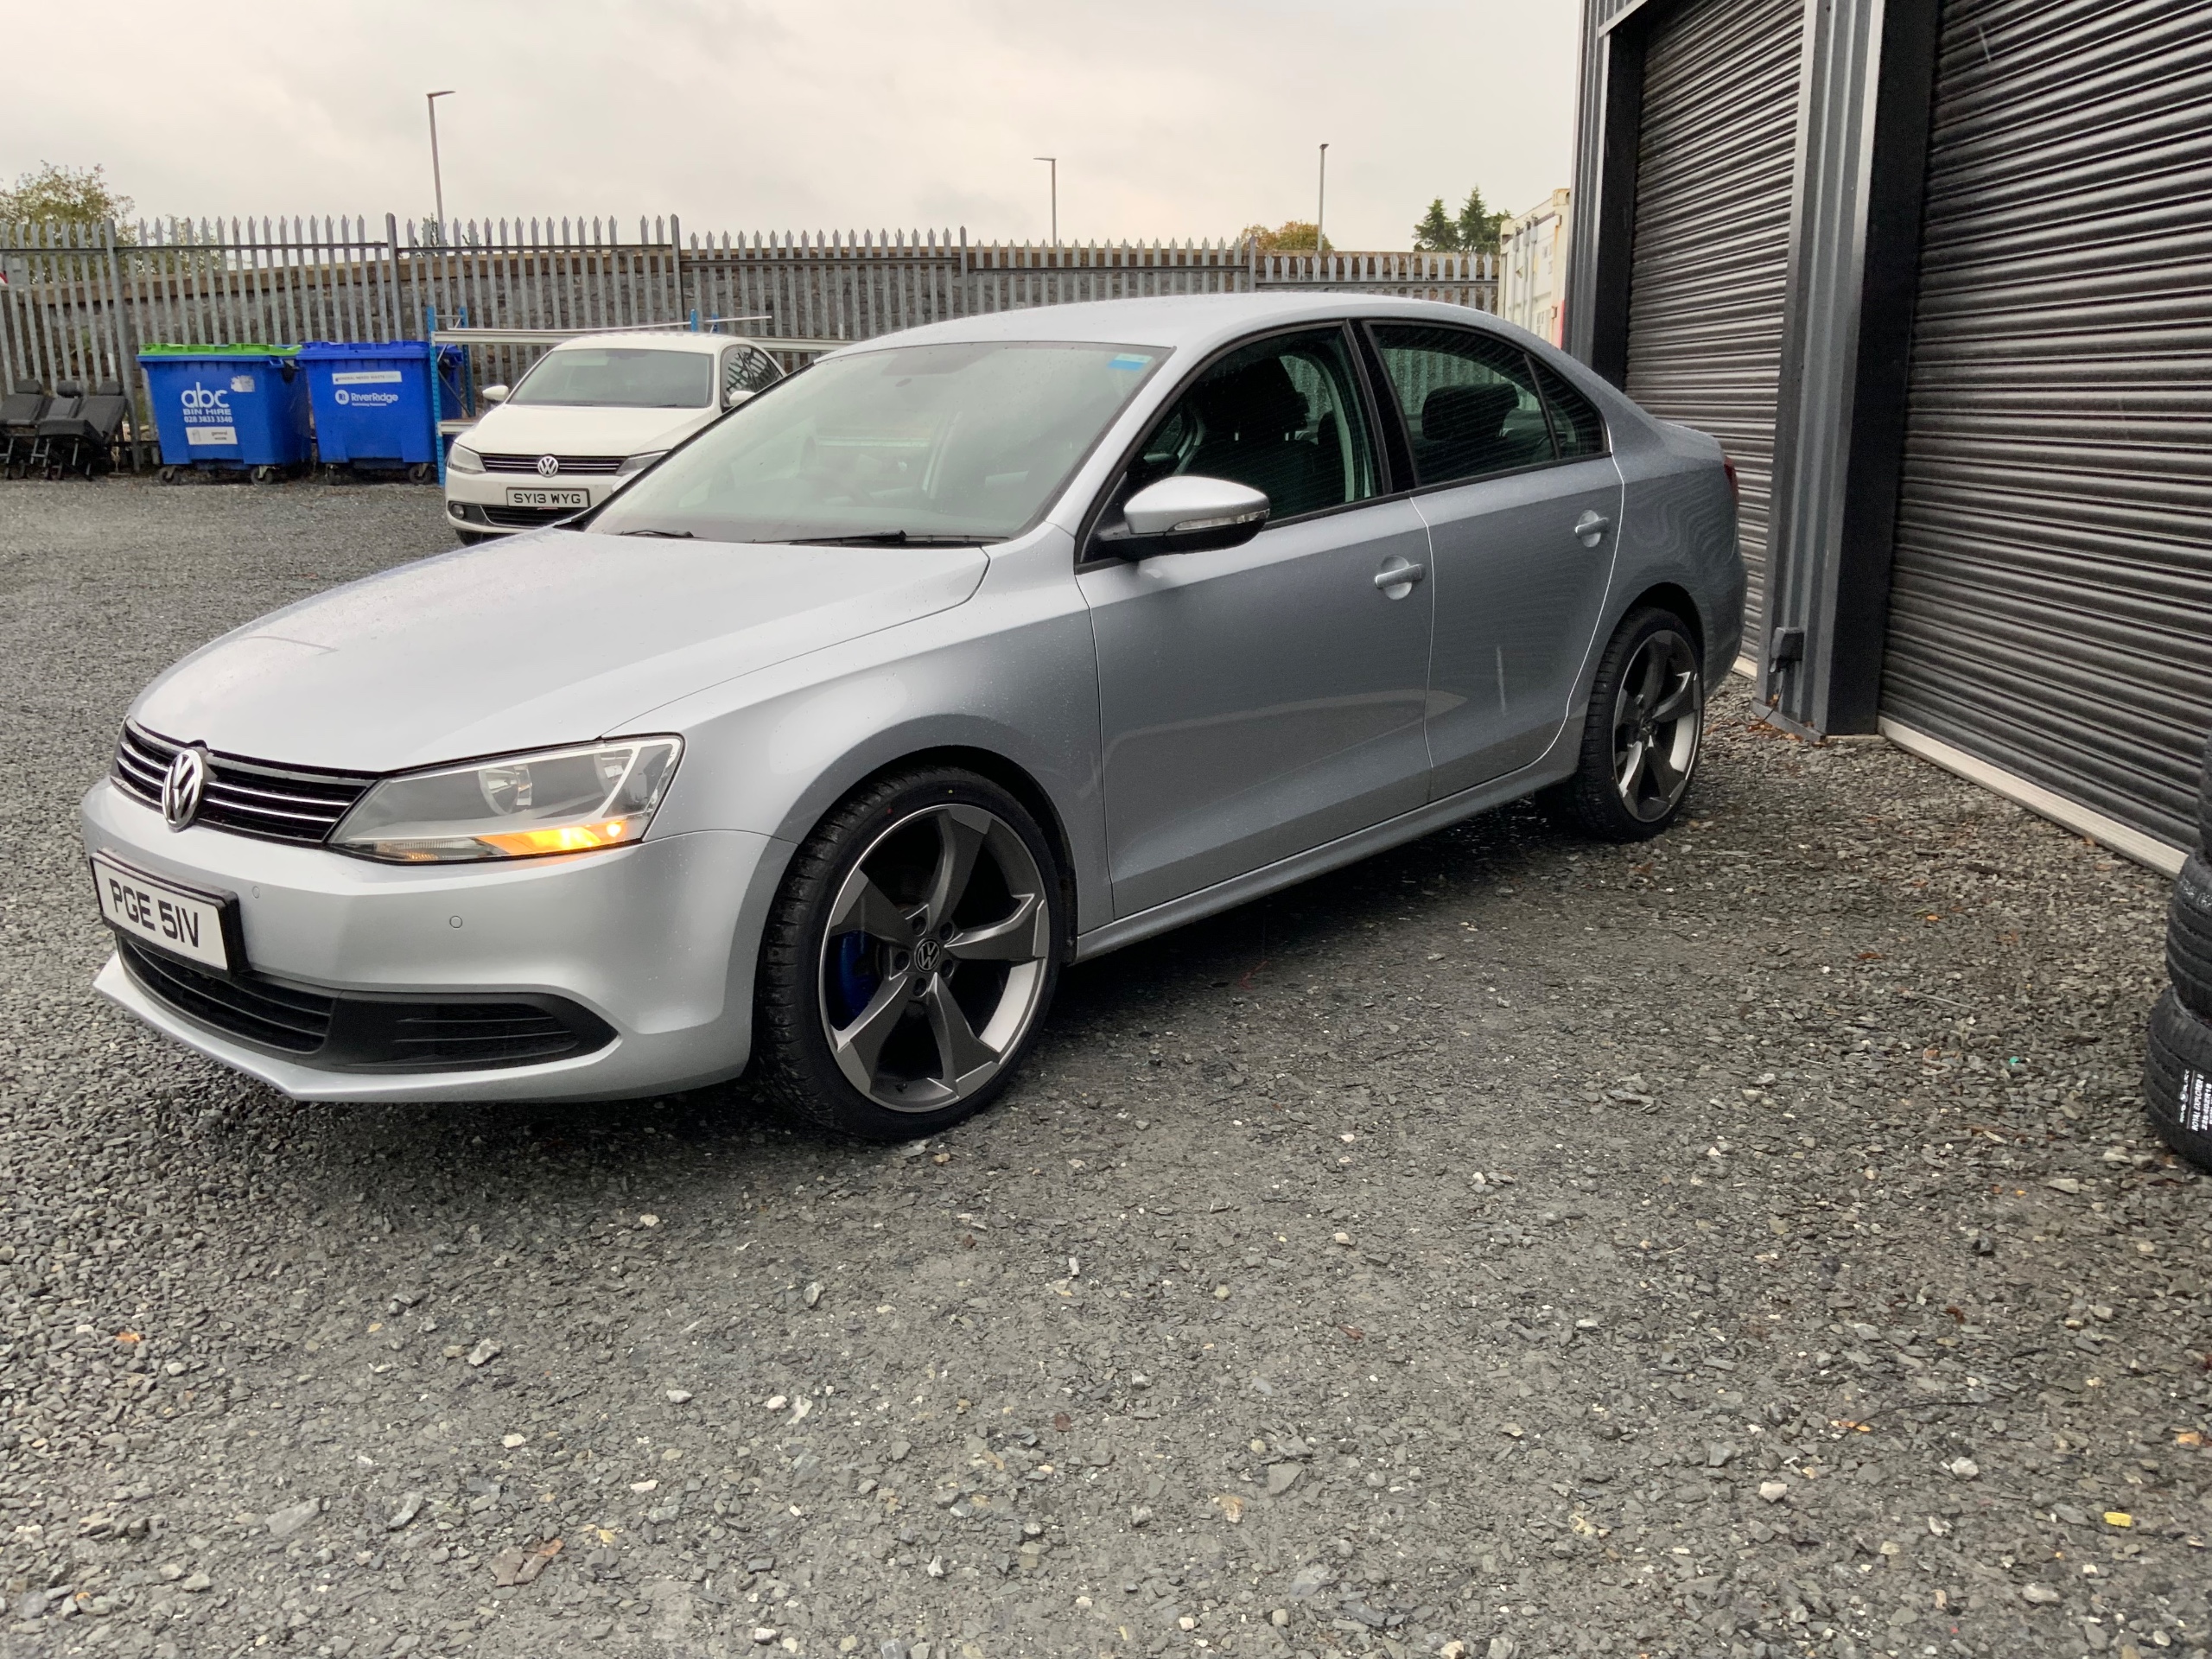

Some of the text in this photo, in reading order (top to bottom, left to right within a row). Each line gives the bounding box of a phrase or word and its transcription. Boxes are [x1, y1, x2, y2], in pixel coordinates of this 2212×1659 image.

[181, 382, 230, 409] abc
[351, 392, 399, 404] RiverRidge
[537, 455, 559, 477] VW
[513, 493, 582, 505] SY13 WYG
[162, 747, 204, 830] VW
[109, 878, 156, 931] PGE
[2194, 1079, 2204, 1110] EXPLORER
[2191, 1110, 2202, 1131] ROYAL
